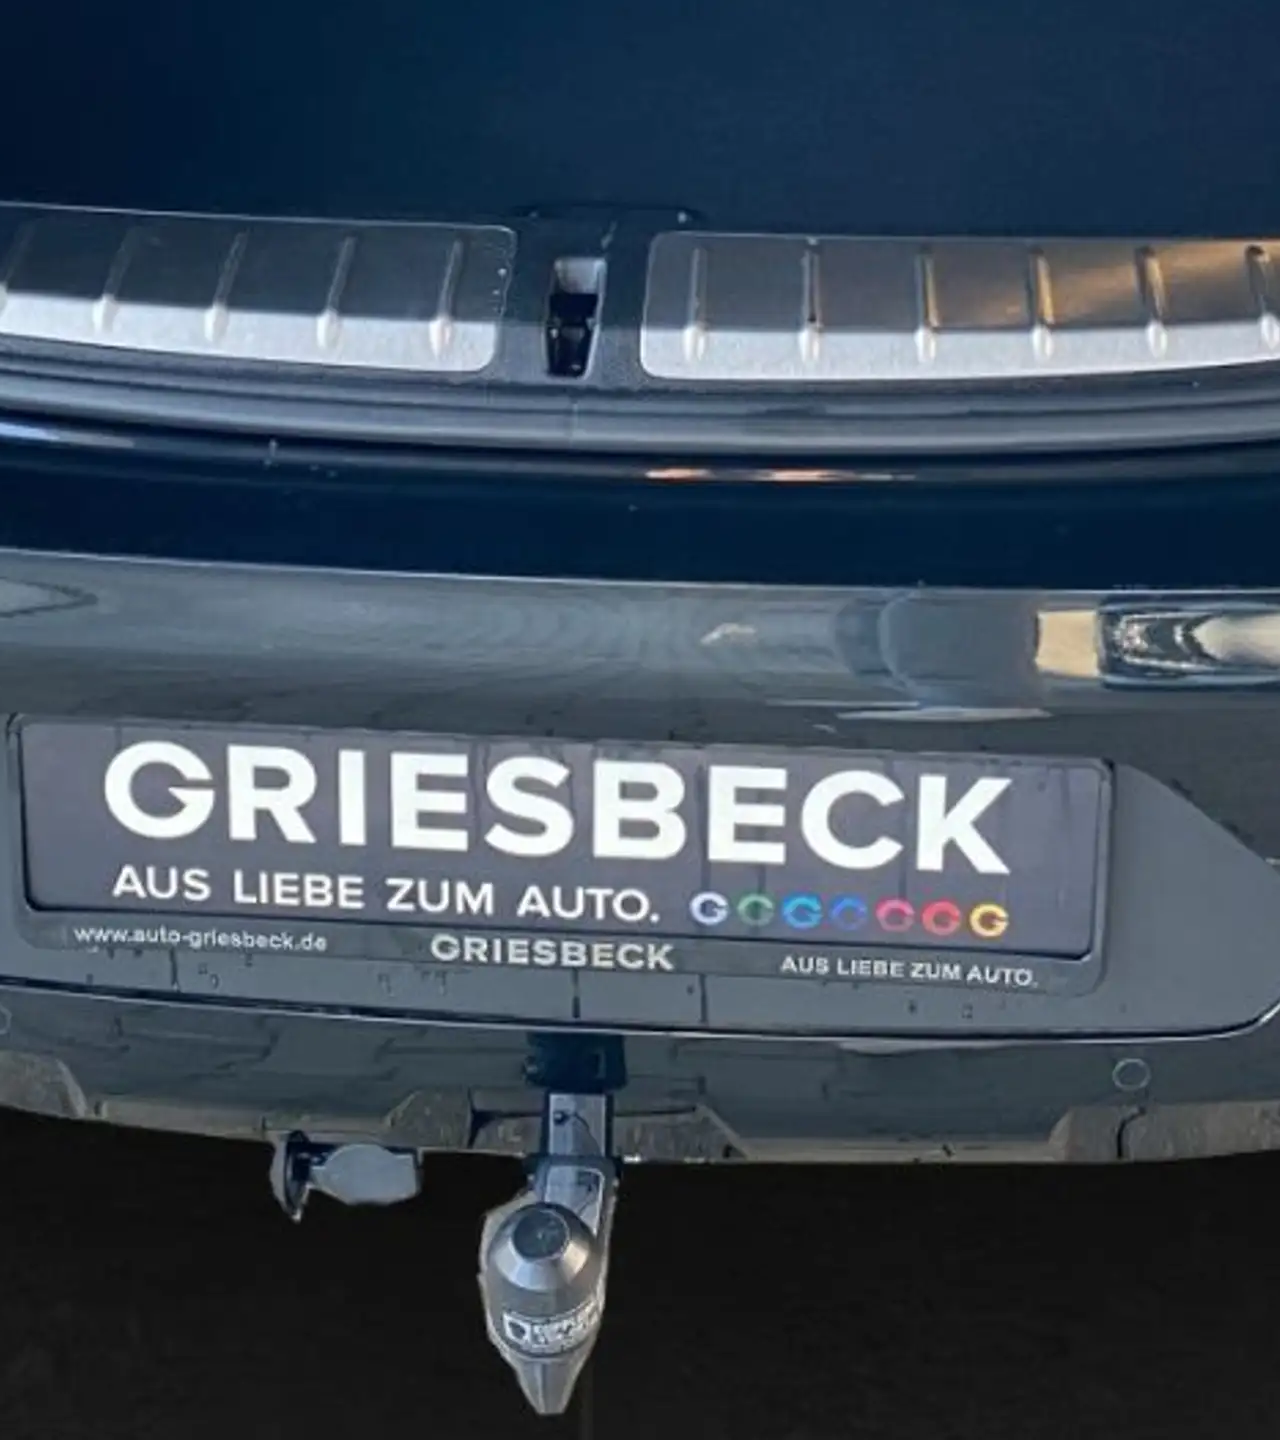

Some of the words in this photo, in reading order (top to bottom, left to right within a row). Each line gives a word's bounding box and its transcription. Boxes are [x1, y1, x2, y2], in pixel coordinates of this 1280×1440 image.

[104, 740, 1012, 875] GRIESBECK
[111, 864, 212, 901] AUS
[232, 870, 365, 910] LIEBE
[385, 876, 495, 916] ZUM
[516, 884, 661, 923] AUTO.
[73, 923, 329, 952] www.auto-griesbeck.de
[429, 932, 675, 971] GRIESBECK
[779, 954, 830, 976] AUS
[836, 957, 905, 979] LIEBE
[909, 961, 962, 982] ZUM
[966, 965, 1040, 989] AUTO.
